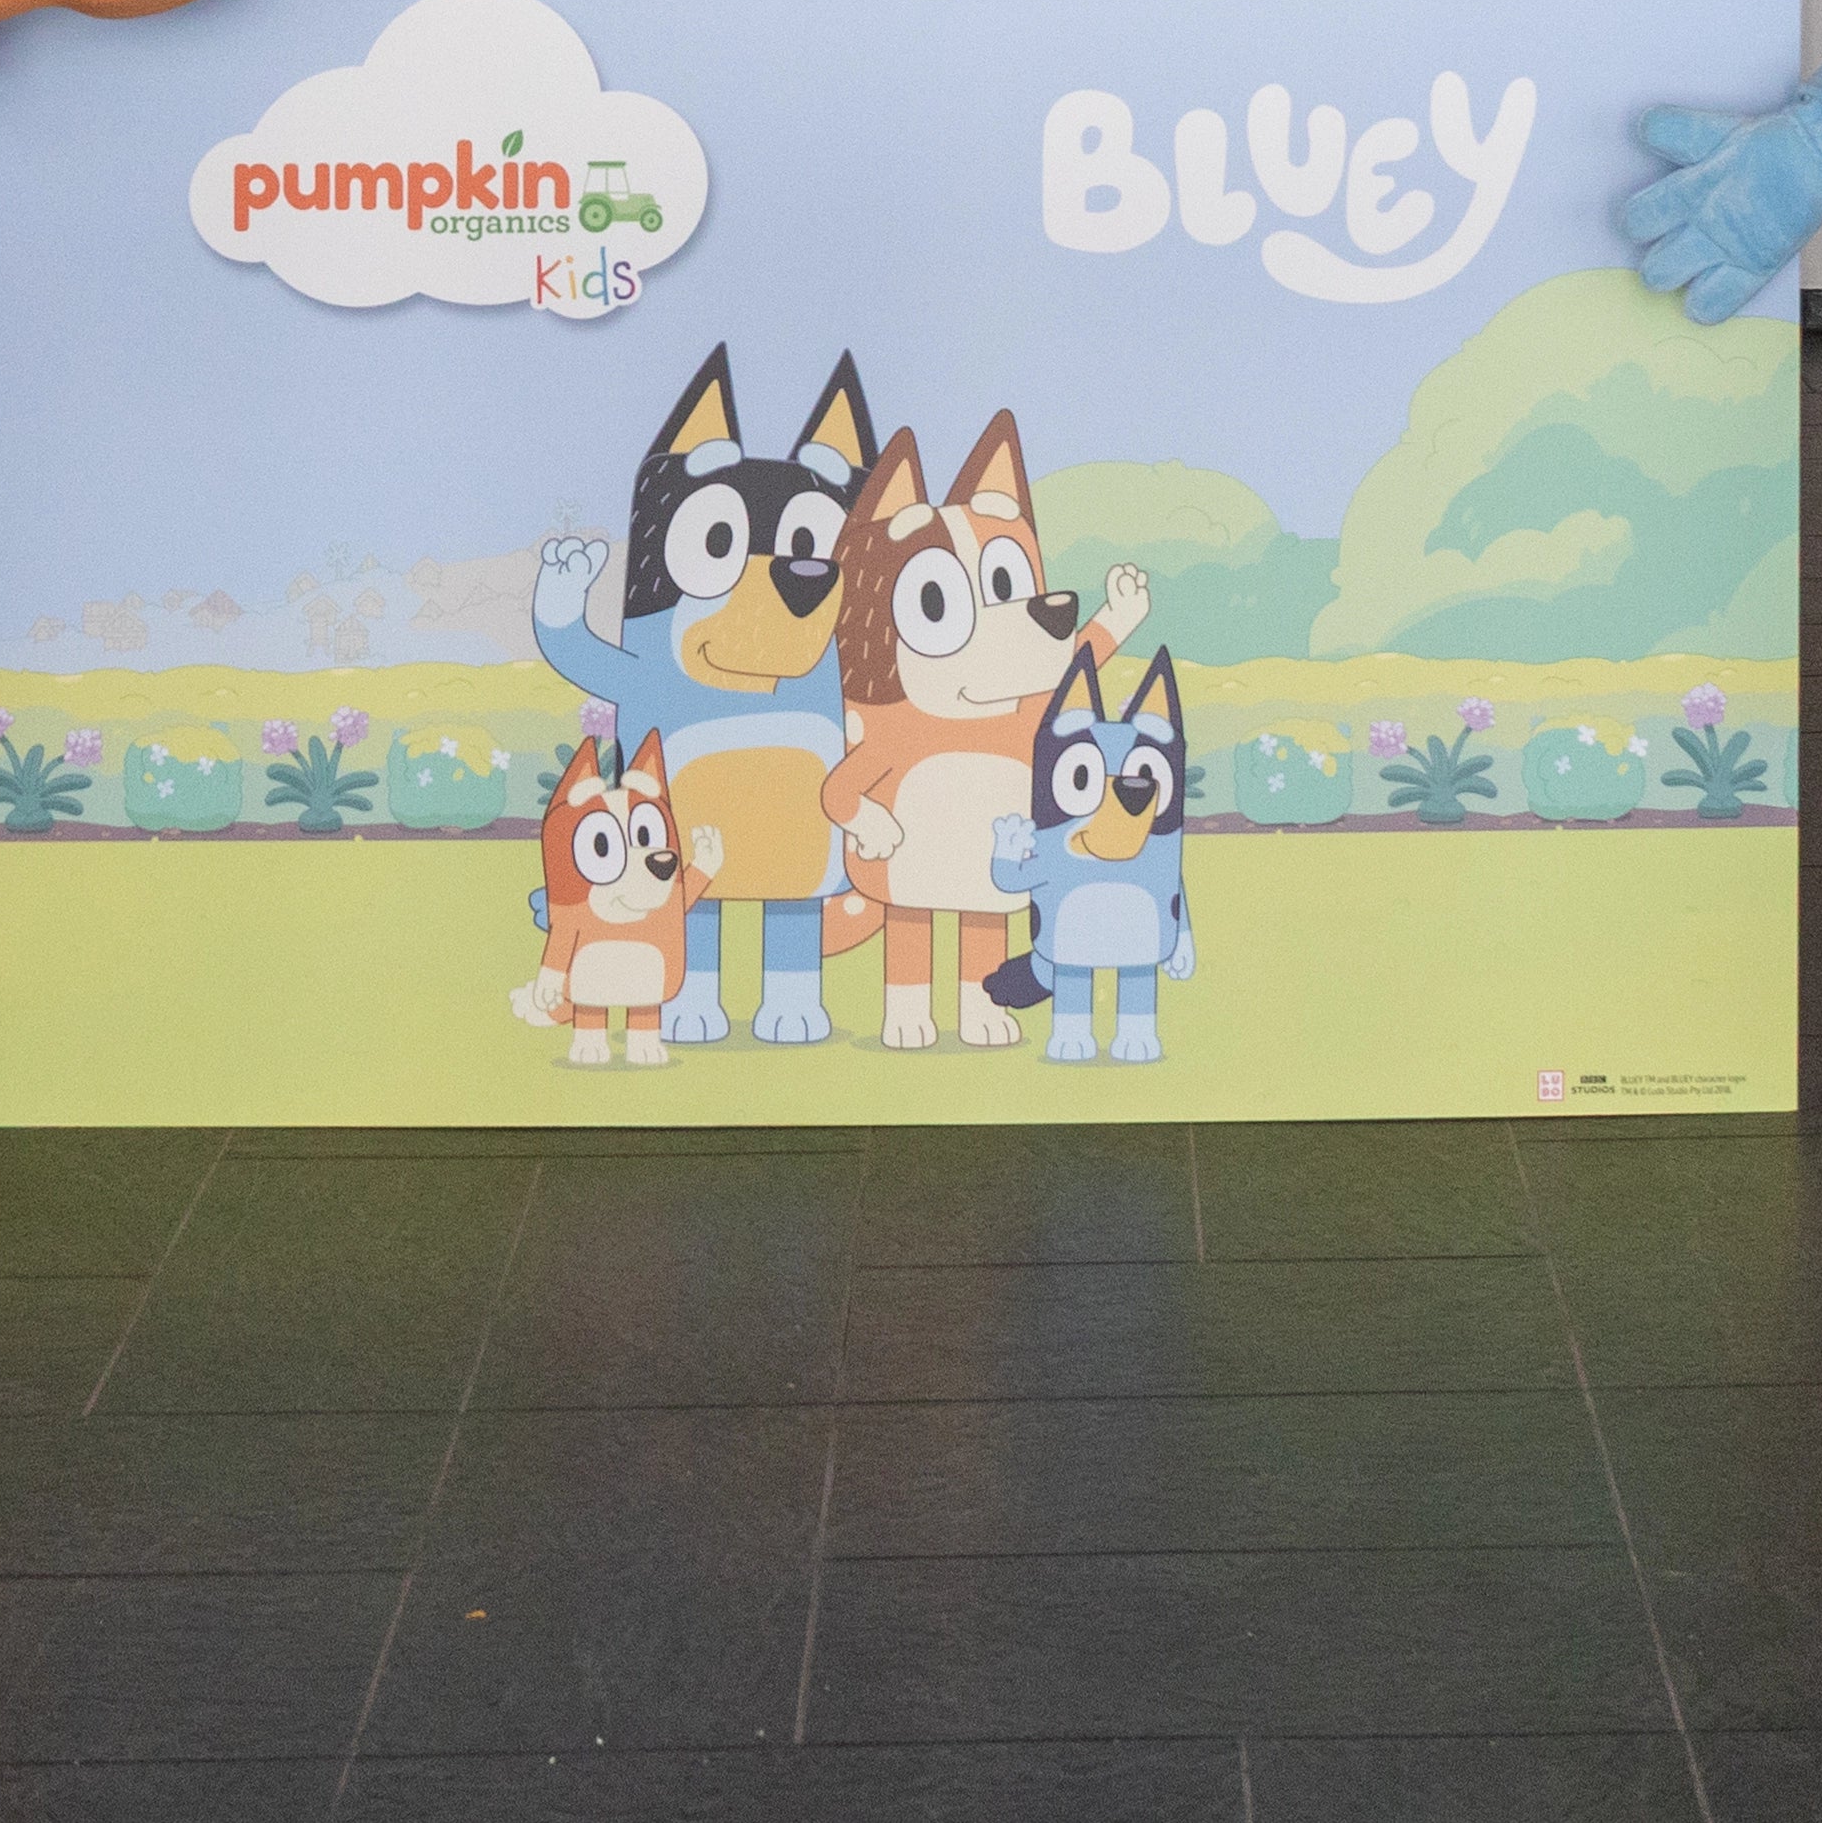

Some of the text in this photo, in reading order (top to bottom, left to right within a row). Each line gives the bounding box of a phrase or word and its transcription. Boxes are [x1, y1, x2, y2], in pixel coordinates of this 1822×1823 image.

[234, 131, 570, 231] pumpkin
[1043, 71, 1537, 303] BLUEY
[430, 214, 570, 241] organics
[535, 246, 637, 306] Kids
[1571, 1085, 1615, 1095] STUDIOS
